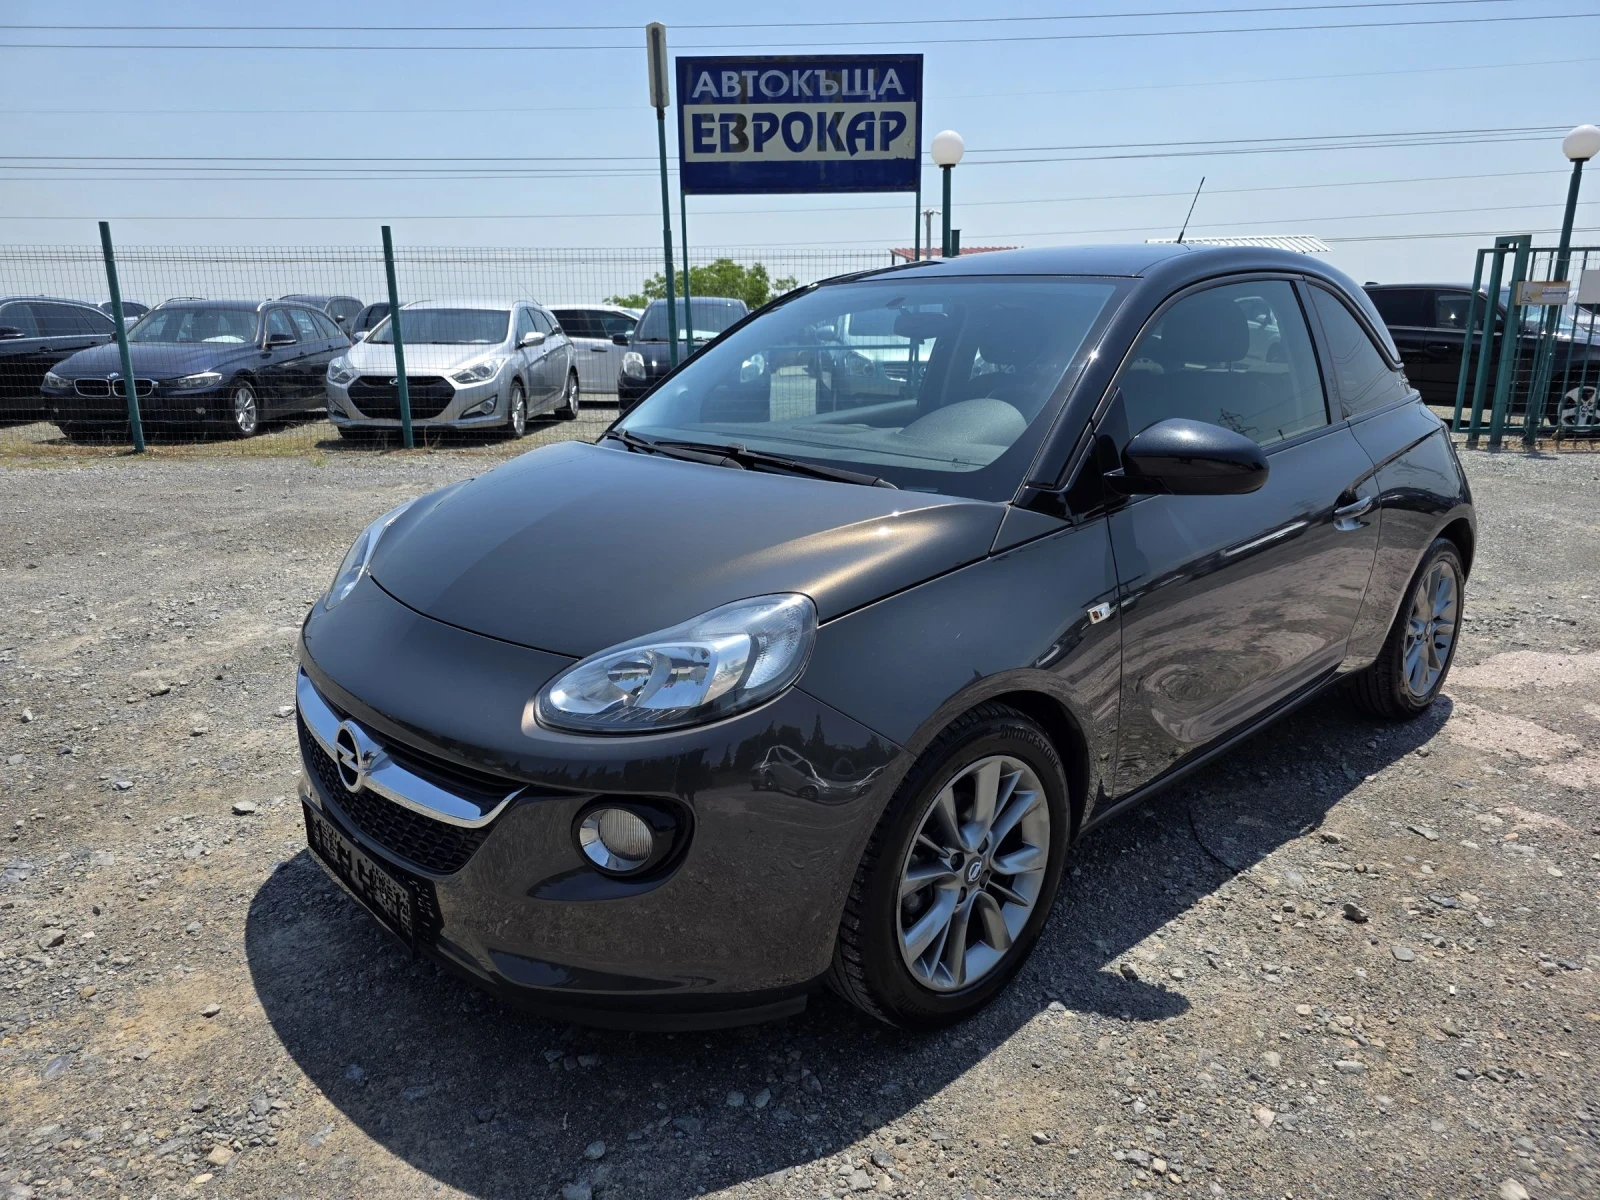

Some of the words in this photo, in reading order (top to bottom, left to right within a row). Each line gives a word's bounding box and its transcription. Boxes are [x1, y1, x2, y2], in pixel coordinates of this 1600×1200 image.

[692, 69, 904, 100] АВТОКЪЩА
[692, 111, 907, 156] ЕВРОКАР
[1001, 726, 1059, 769] BRIDGESTONE
